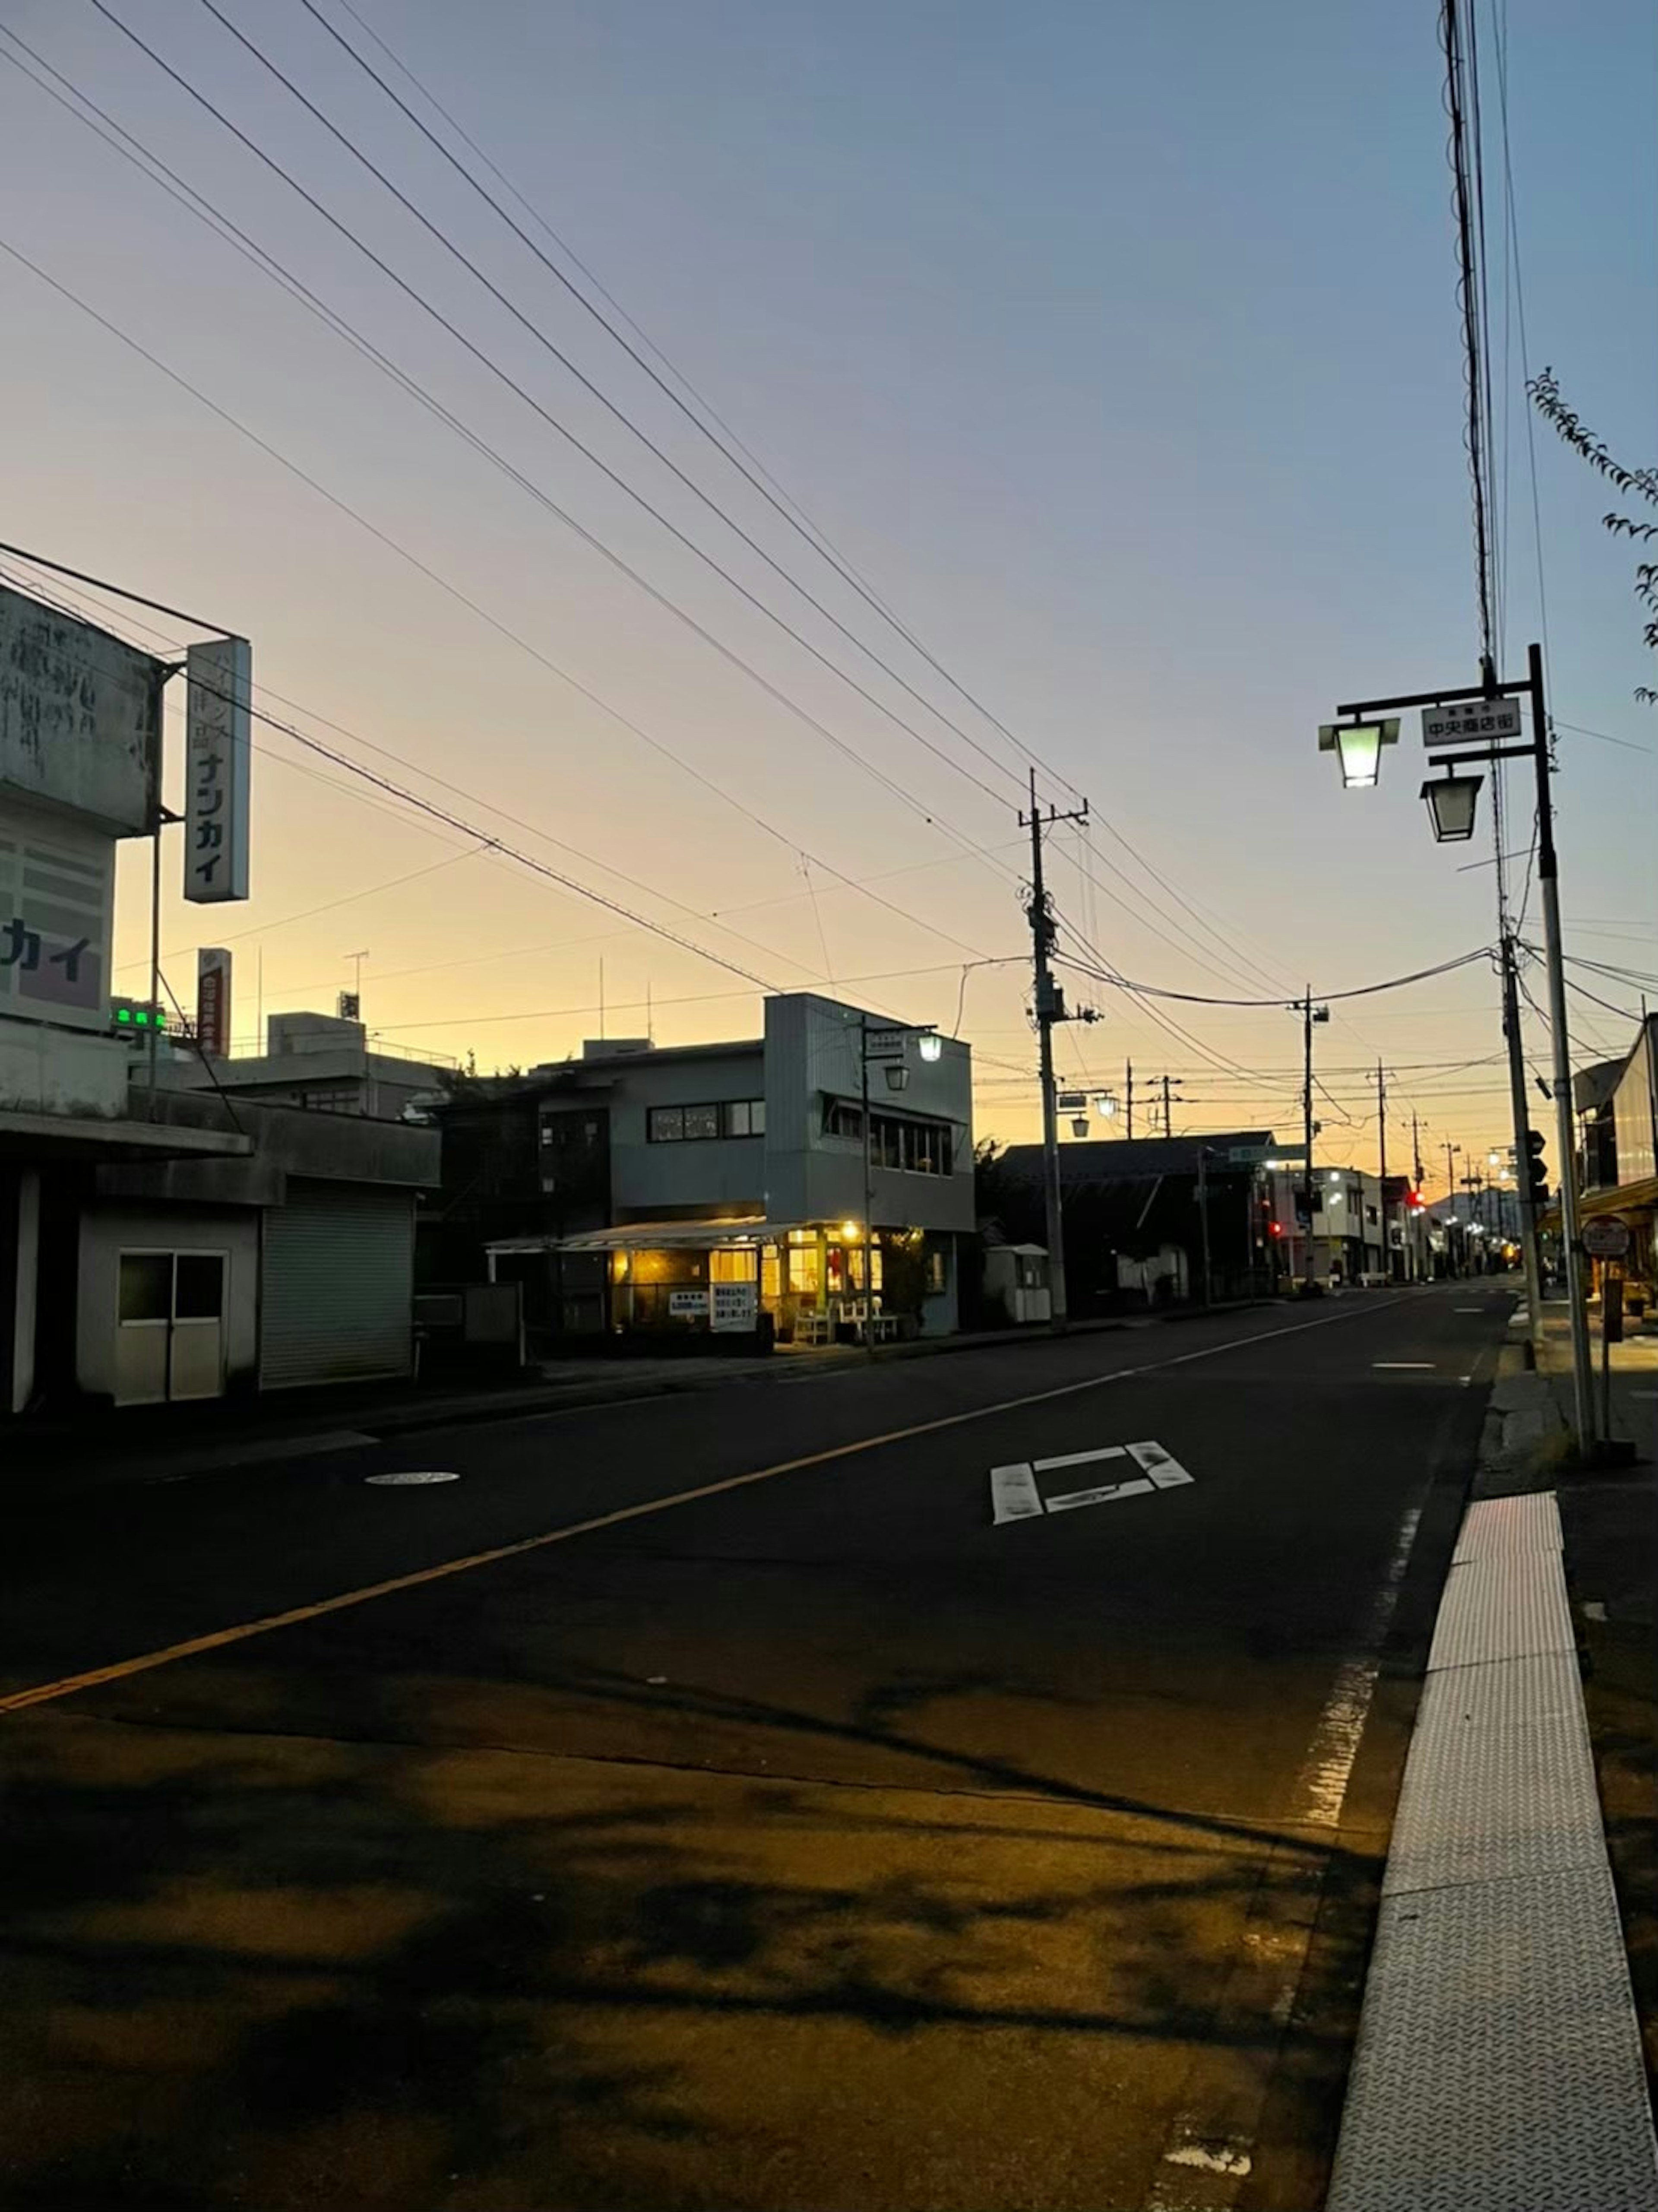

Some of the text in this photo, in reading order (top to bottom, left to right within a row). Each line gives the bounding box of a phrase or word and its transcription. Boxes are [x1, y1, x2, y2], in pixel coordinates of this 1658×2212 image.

[1429, 713, 1513, 738] 中央商店街
[196, 754, 223, 883] ナンカイ
[0, 918, 90, 982] カイ
